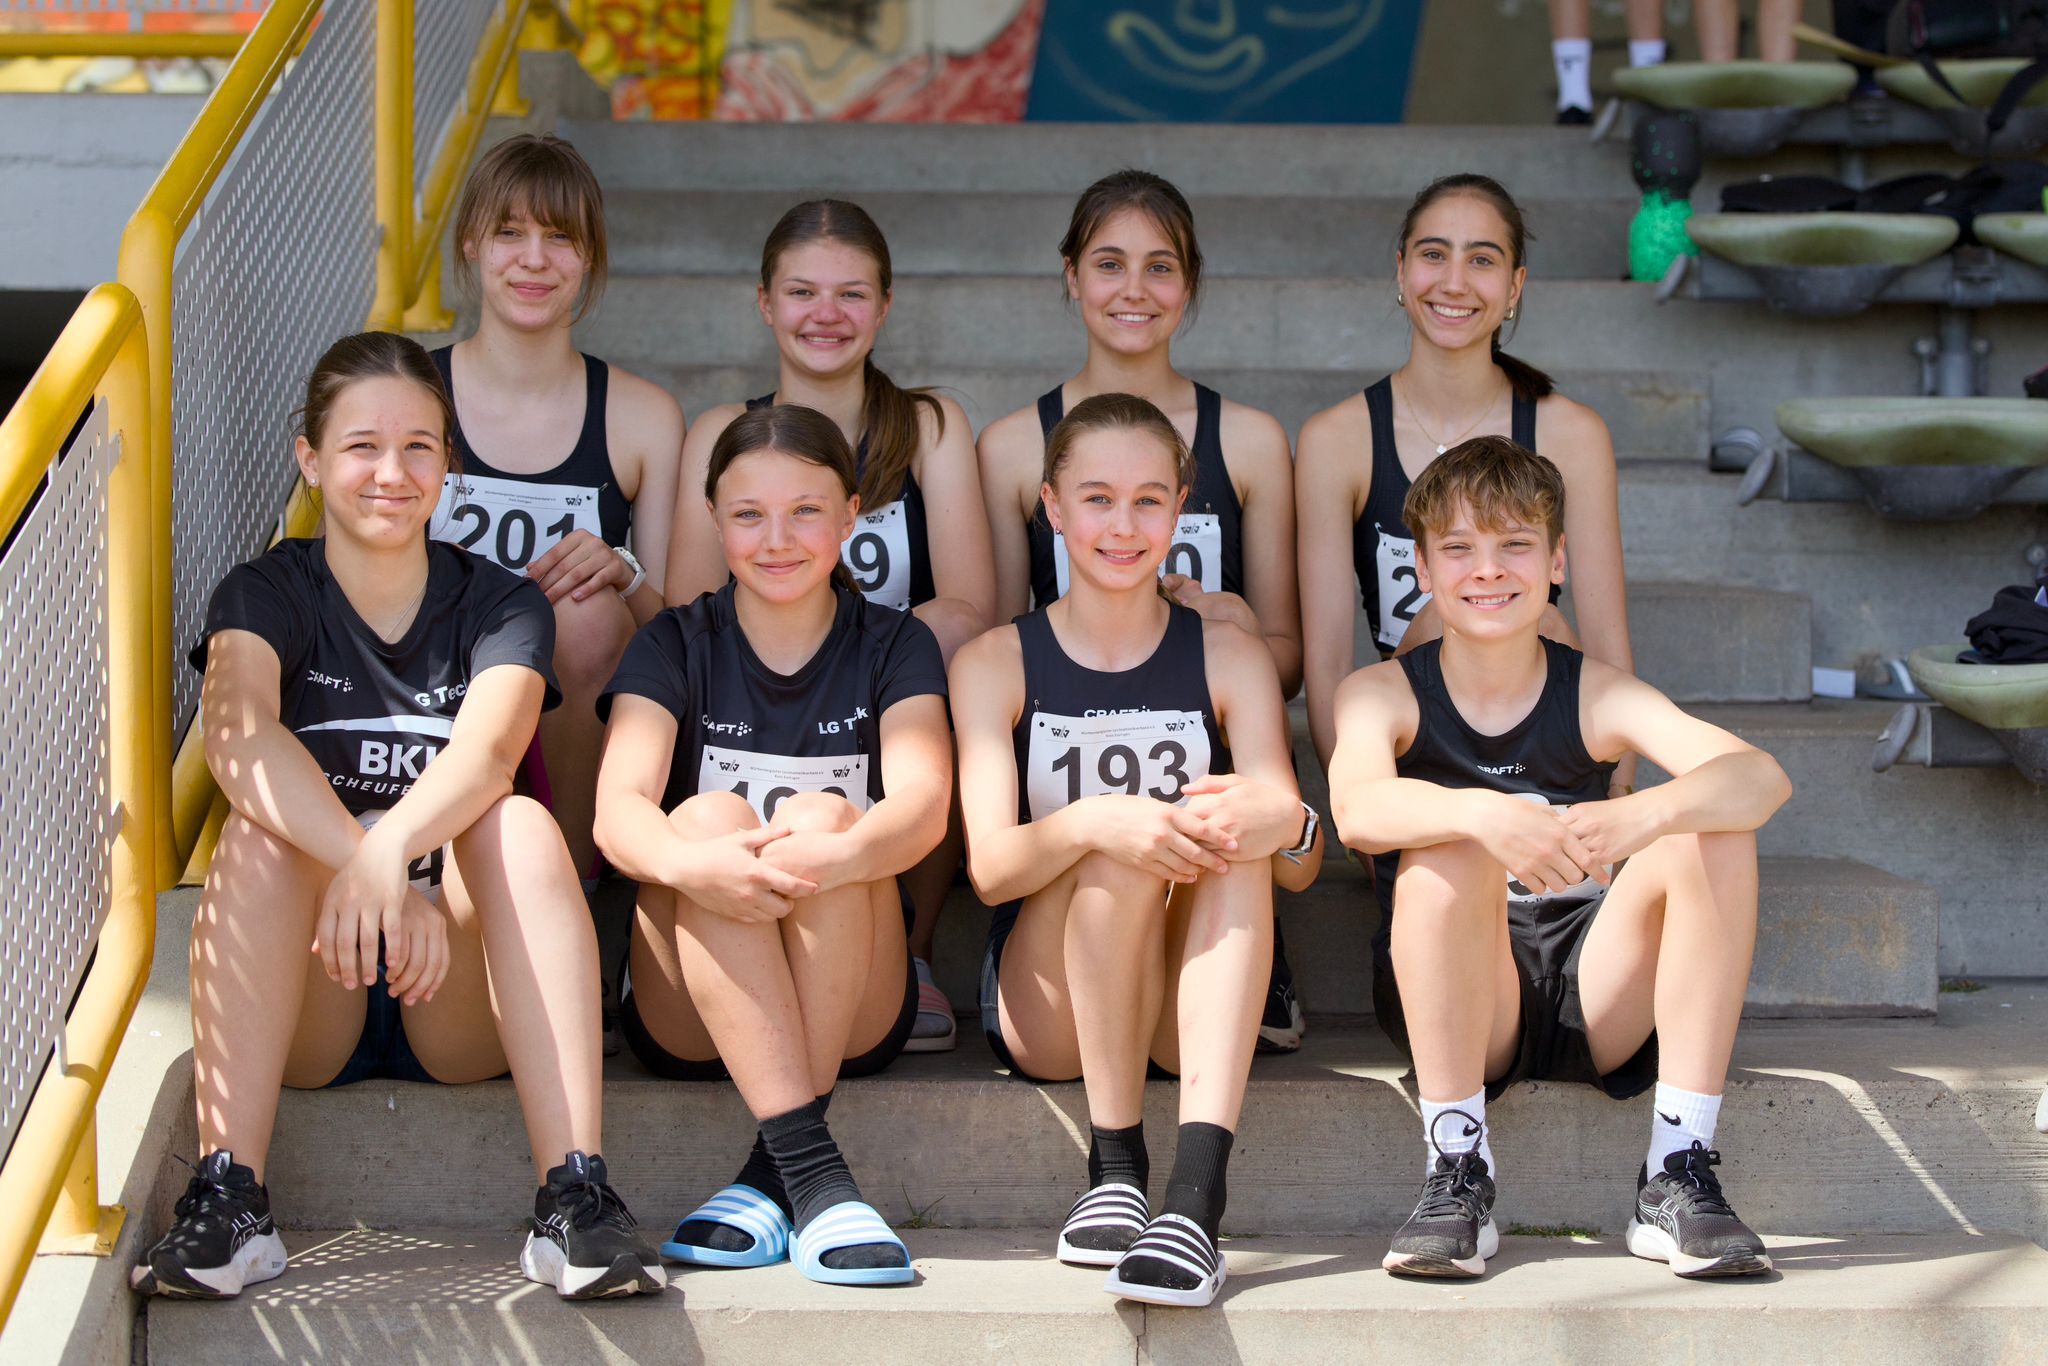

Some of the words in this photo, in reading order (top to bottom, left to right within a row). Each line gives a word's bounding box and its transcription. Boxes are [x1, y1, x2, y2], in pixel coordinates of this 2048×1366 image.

[849, 532, 891, 593] 9
[434, 678, 469, 705] Tec
[702, 714, 737, 735] CAFT
[818, 721, 840, 735] LG
[844, 706, 869, 731] Tk
[1052, 740, 1190, 805] 193
